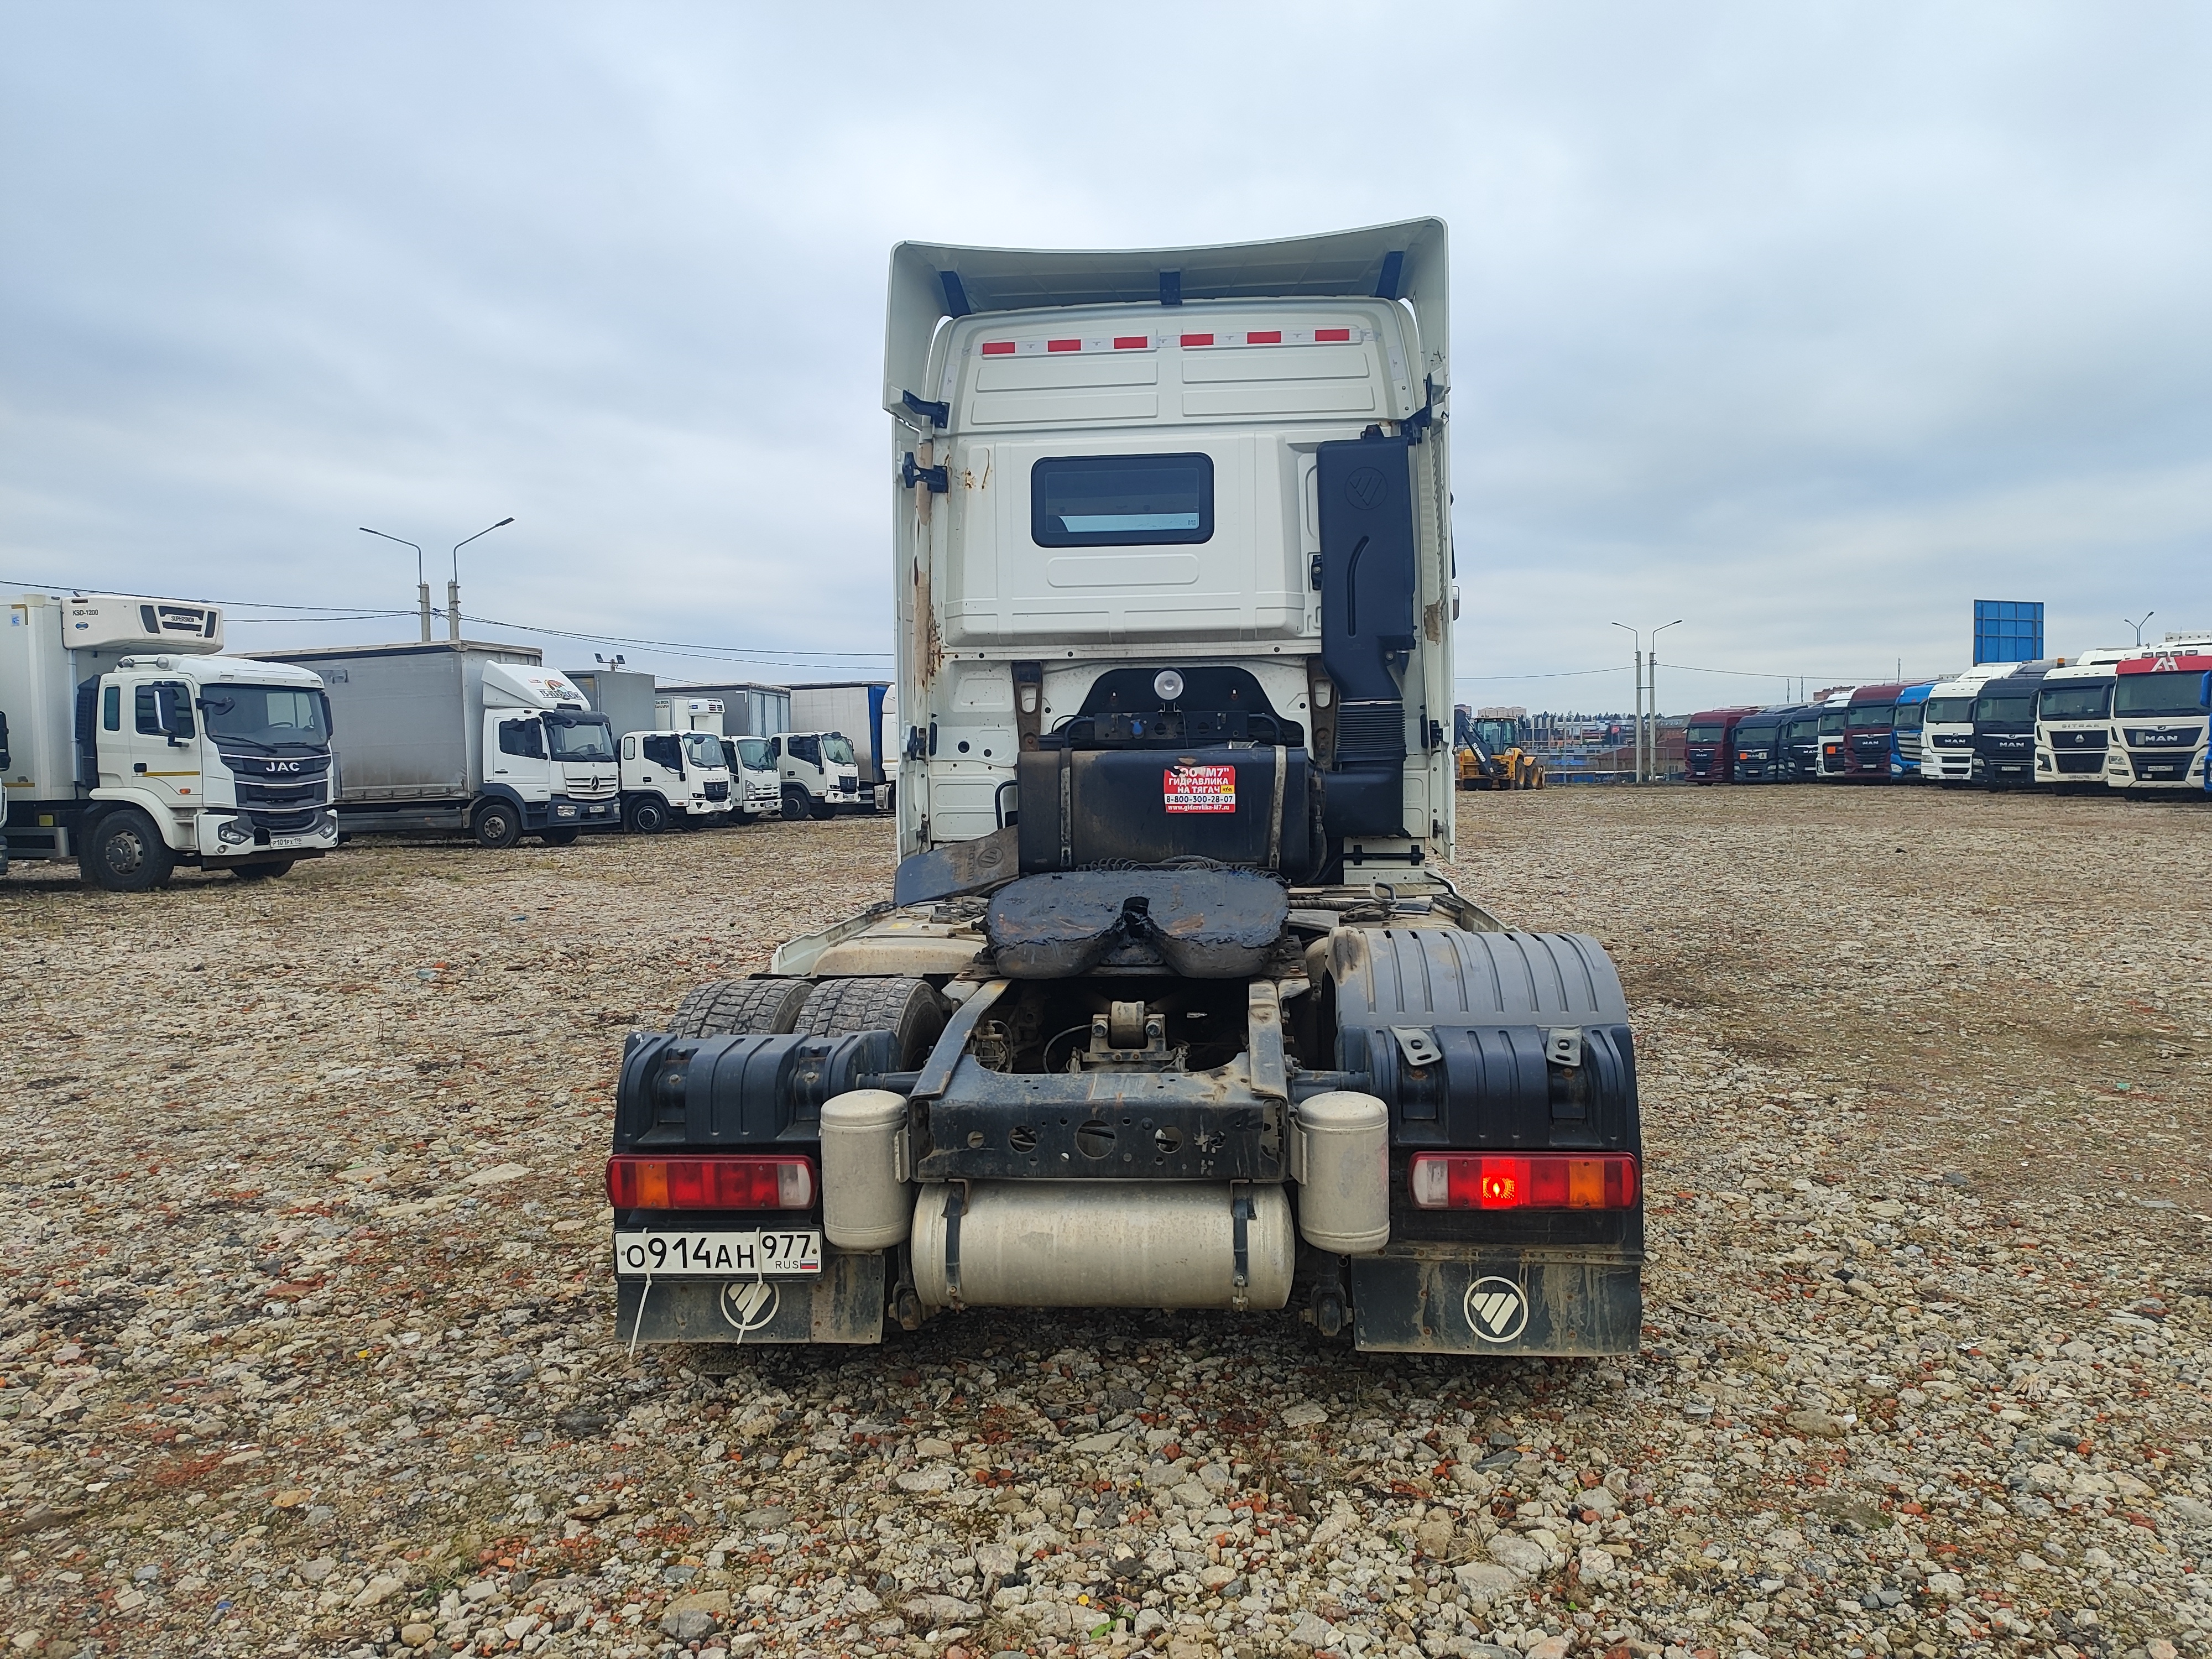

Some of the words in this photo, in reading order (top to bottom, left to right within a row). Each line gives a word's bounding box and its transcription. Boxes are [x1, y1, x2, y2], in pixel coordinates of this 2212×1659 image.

[265, 762, 300, 772] JAC
[1168, 778, 1229, 786] ГИДРАВЛИКА
[627, 1237, 754, 1269] О914АН
[761, 1235, 811, 1259] 977
[775, 1260, 799, 1269] RUS
